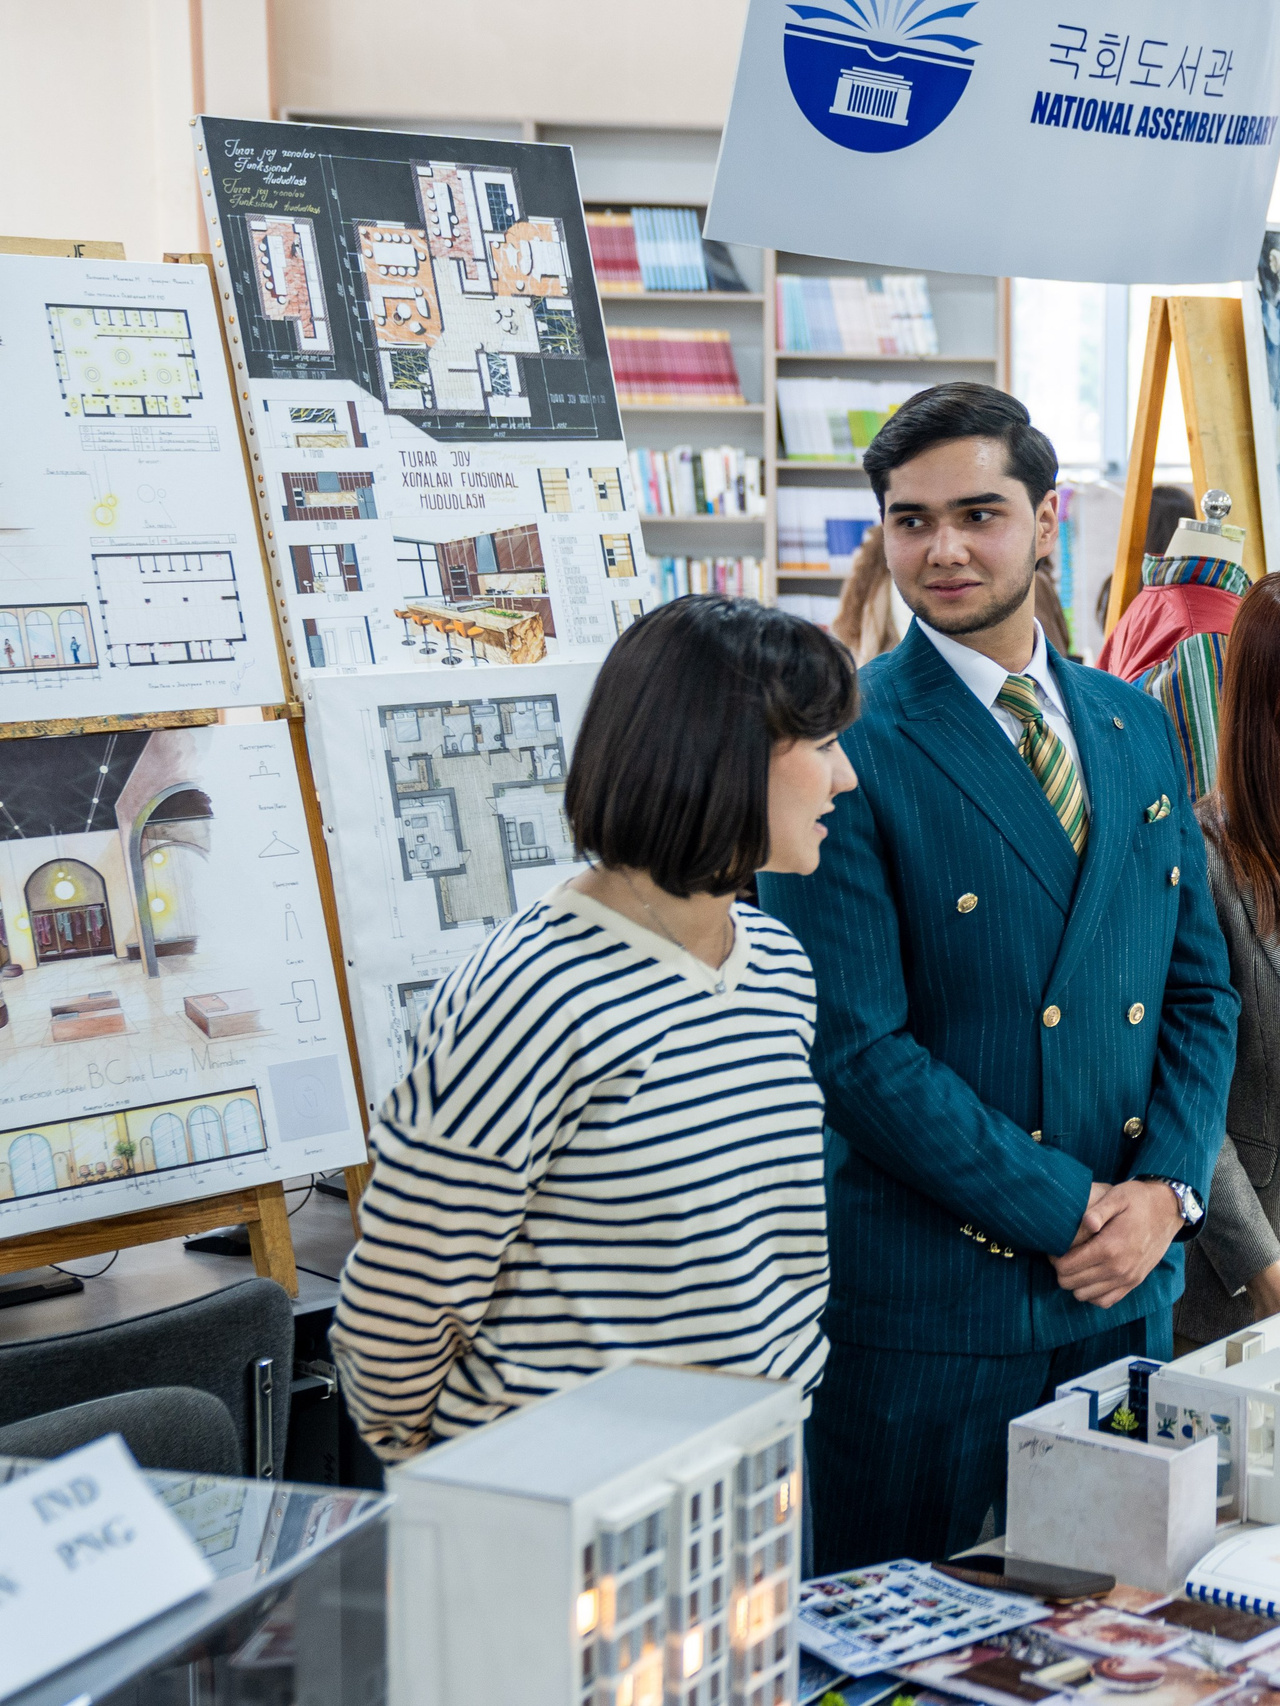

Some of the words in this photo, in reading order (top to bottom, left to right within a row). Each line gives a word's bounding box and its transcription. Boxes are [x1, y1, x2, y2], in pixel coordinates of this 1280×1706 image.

[1049, 24, 1234, 99] 국회도서관
[1030, 90, 1134, 136] NATIONAL
[1134, 106, 1227, 145] ASSEMBLY
[1223, 114, 1279, 147] LIBRARY
[398, 450, 438, 468] TURAR
[450, 450, 471, 467] JOY
[401, 471, 453, 488] XONALARI
[460, 471, 519, 489] FUNSIONAL
[420, 493, 486, 511] HUDUDLASH
